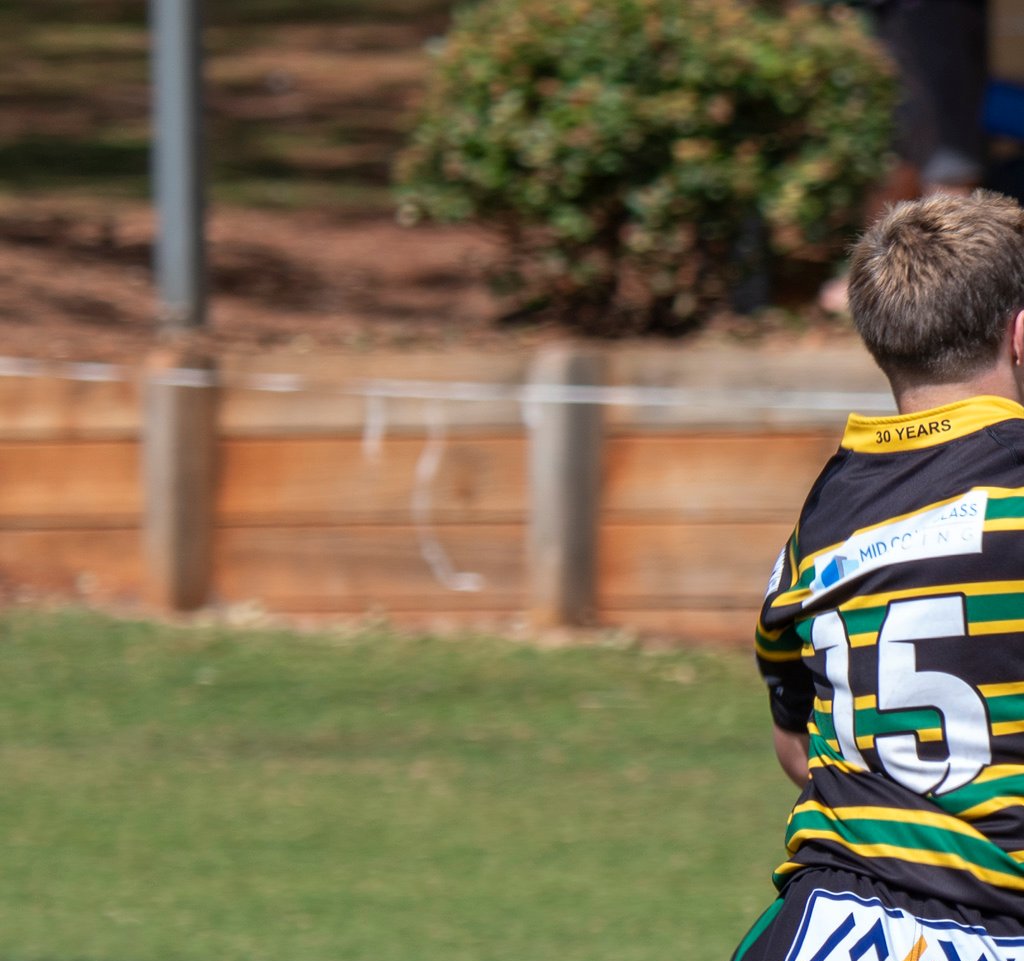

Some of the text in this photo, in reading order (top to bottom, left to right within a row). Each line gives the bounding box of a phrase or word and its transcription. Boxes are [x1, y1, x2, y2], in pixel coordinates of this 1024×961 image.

[876, 419, 951, 444] 30 YEARS
[859, 541, 887, 562] MID
[811, 593, 991, 797] 15
